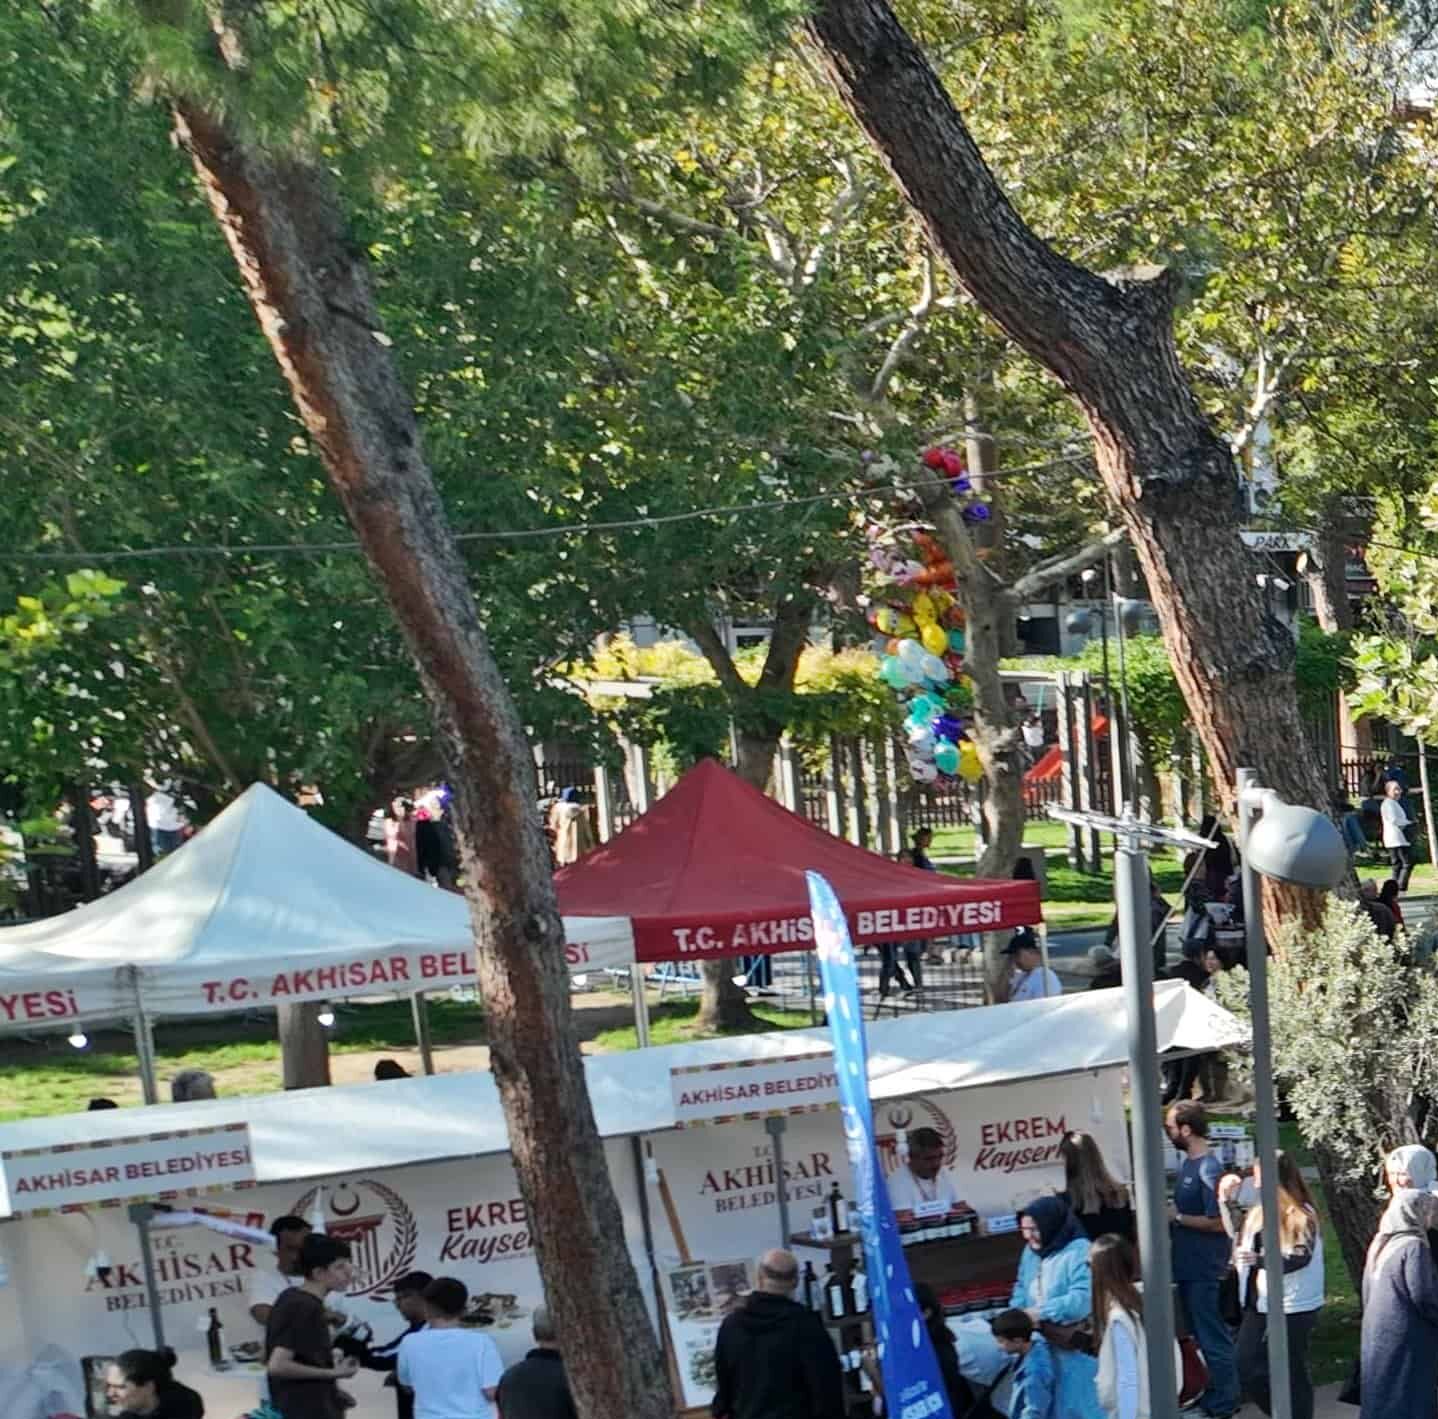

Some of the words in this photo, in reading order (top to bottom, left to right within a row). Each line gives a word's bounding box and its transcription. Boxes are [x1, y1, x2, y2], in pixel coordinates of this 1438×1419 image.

[673, 925, 723, 952] T.C.
[731, 917, 816, 948] AKHiS
[202, 978, 259, 1004] T.C.
[764, 1071, 839, 1097] BELEDİY
[980, 1115, 1068, 1146] EKREM
[15, 1166, 121, 1194] AKHİSAR
[124, 1145, 252, 1181] BELEDİYESİ
[715, 1182, 824, 1213] BELEDYESİ
[446, 1198, 529, 1233] EKRE
